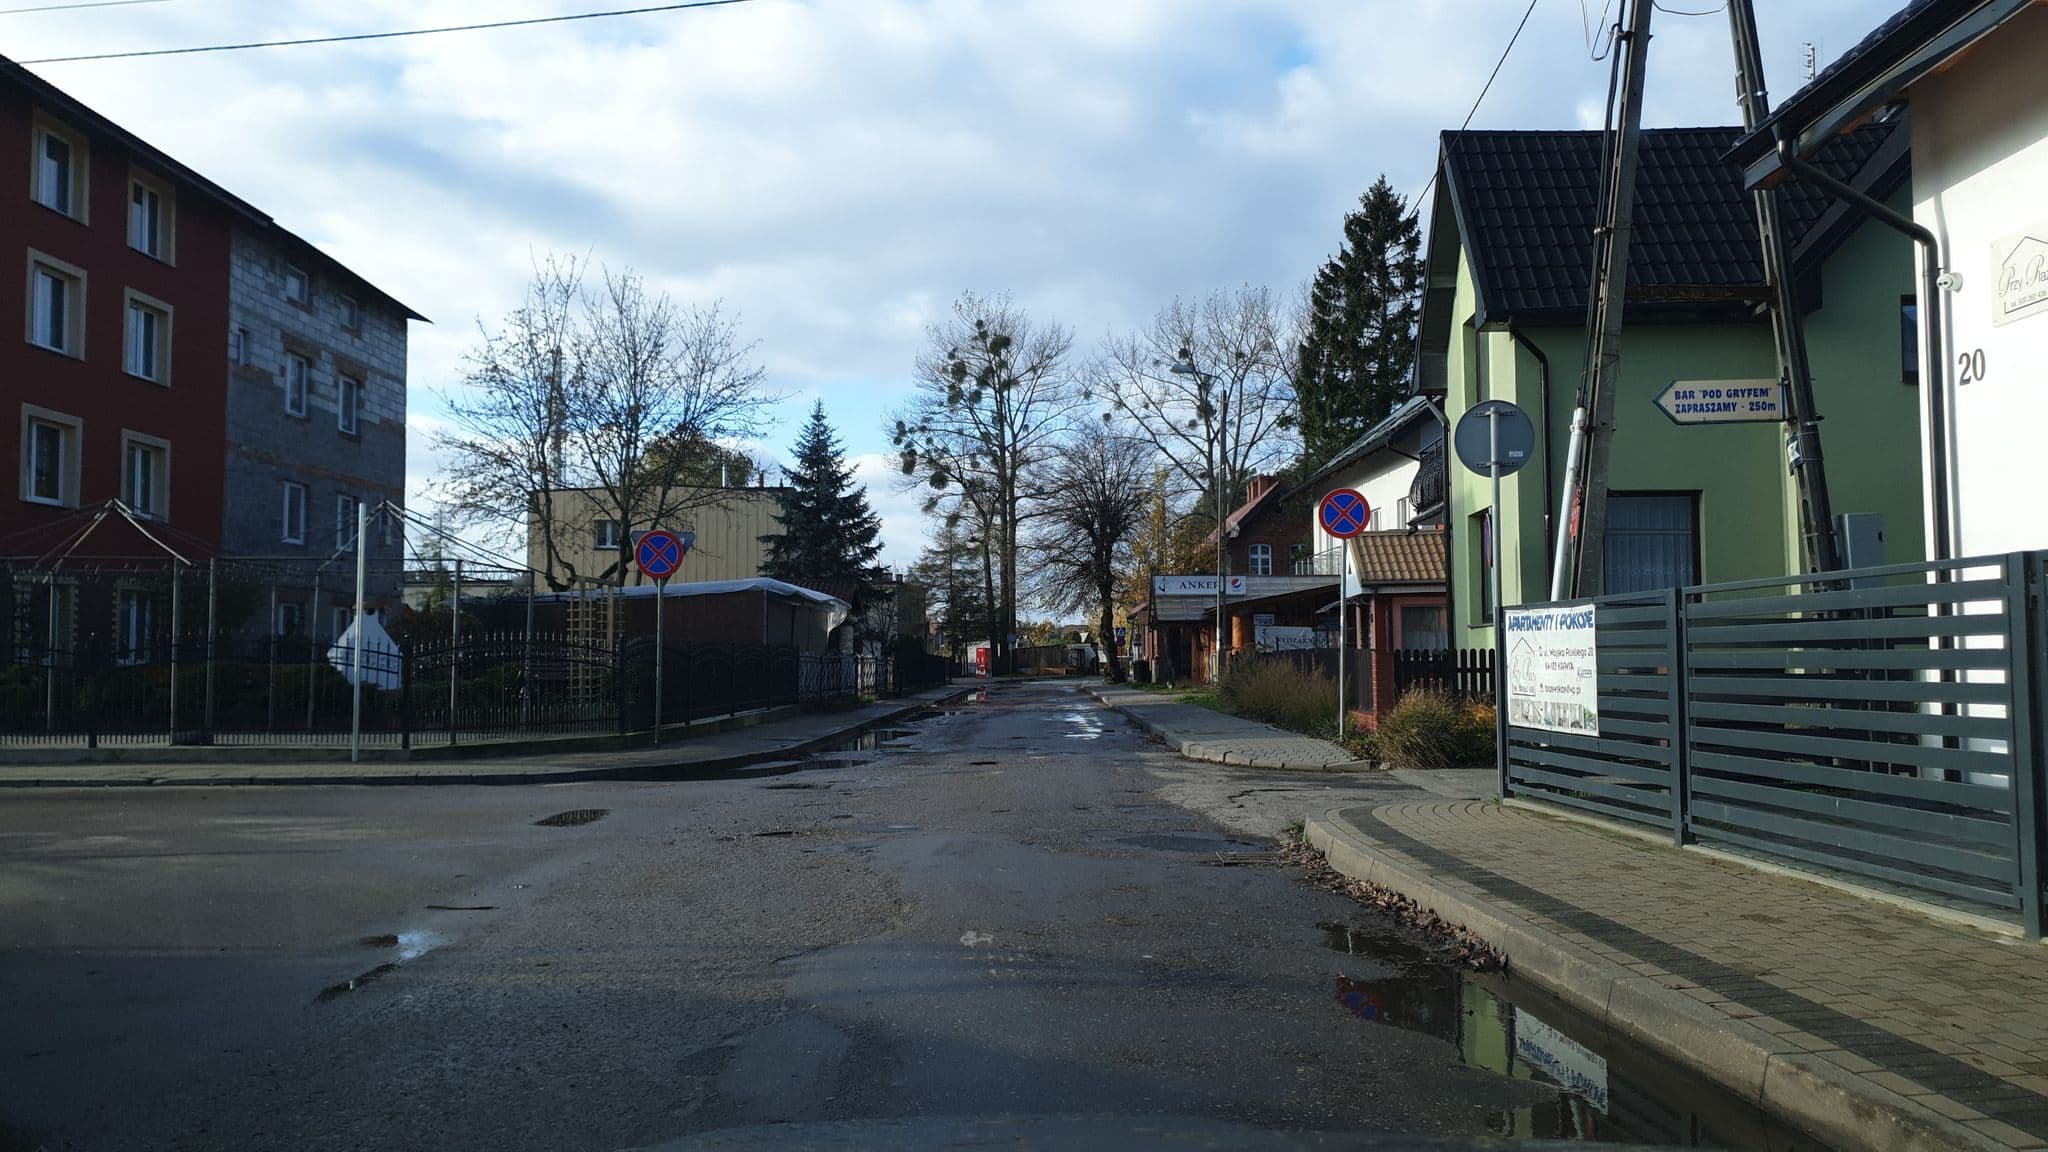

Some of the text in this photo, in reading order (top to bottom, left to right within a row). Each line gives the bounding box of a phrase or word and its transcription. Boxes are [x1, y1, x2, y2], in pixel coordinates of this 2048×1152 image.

[1958, 348, 1986, 386] 20
[1674, 390, 1696, 400] BAR
[1675, 402, 1738, 414] ZAPRASZAMY
[1749, 401, 1776, 412] 250m
[1508, 614, 1554, 632] APARTAMENTY
[1560, 610, 1593, 630] POKOJE
